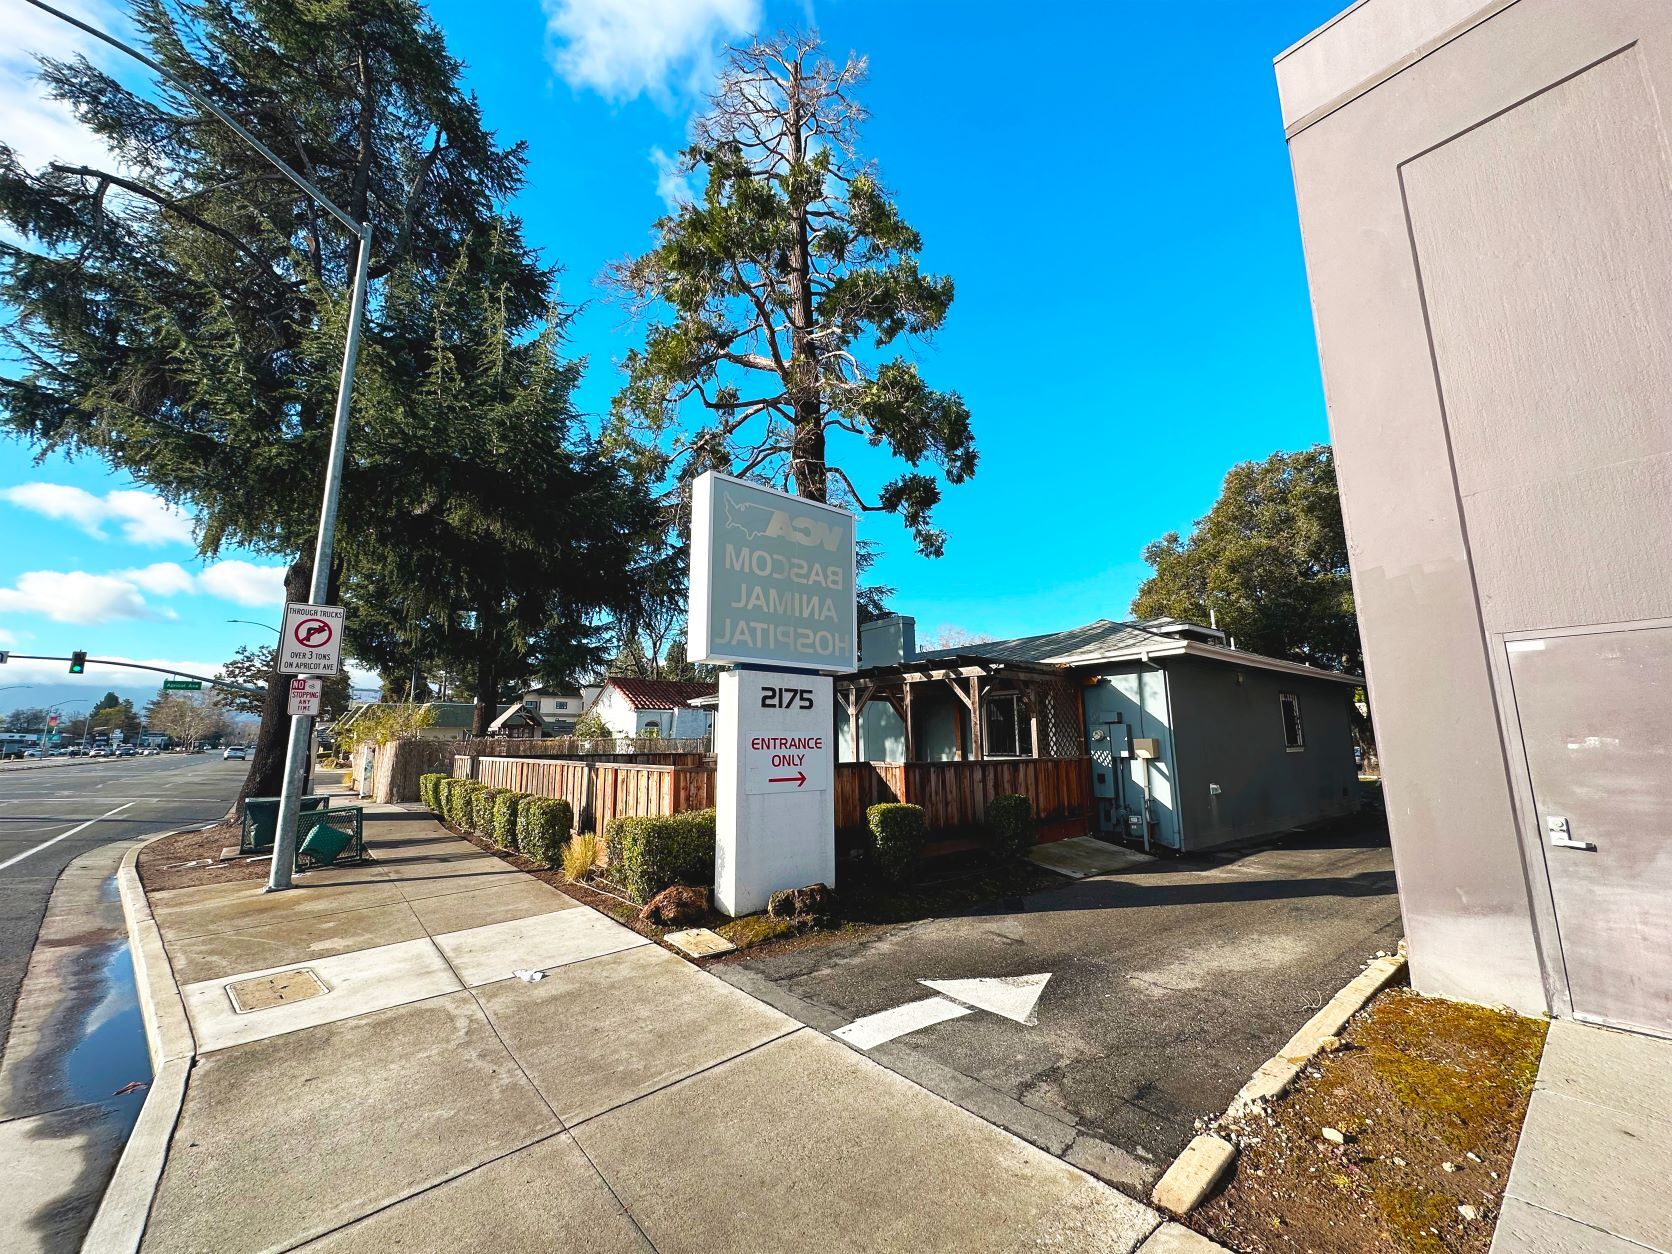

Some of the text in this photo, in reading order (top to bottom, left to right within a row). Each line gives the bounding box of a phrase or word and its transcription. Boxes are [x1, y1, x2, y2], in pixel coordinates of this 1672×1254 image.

[289, 607, 343, 619] THROUGH TRUCKS
[290, 650, 331, 661] OVER 3 TONS
[284, 661, 334, 671] ON APRICOT AVE
[292, 680, 305, 690] NO
[292, 691, 319, 699] STOPPING
[761, 686, 814, 710] 2175
[751, 737, 823, 750] ENTRANCE
[771, 754, 806, 768] ONLY
